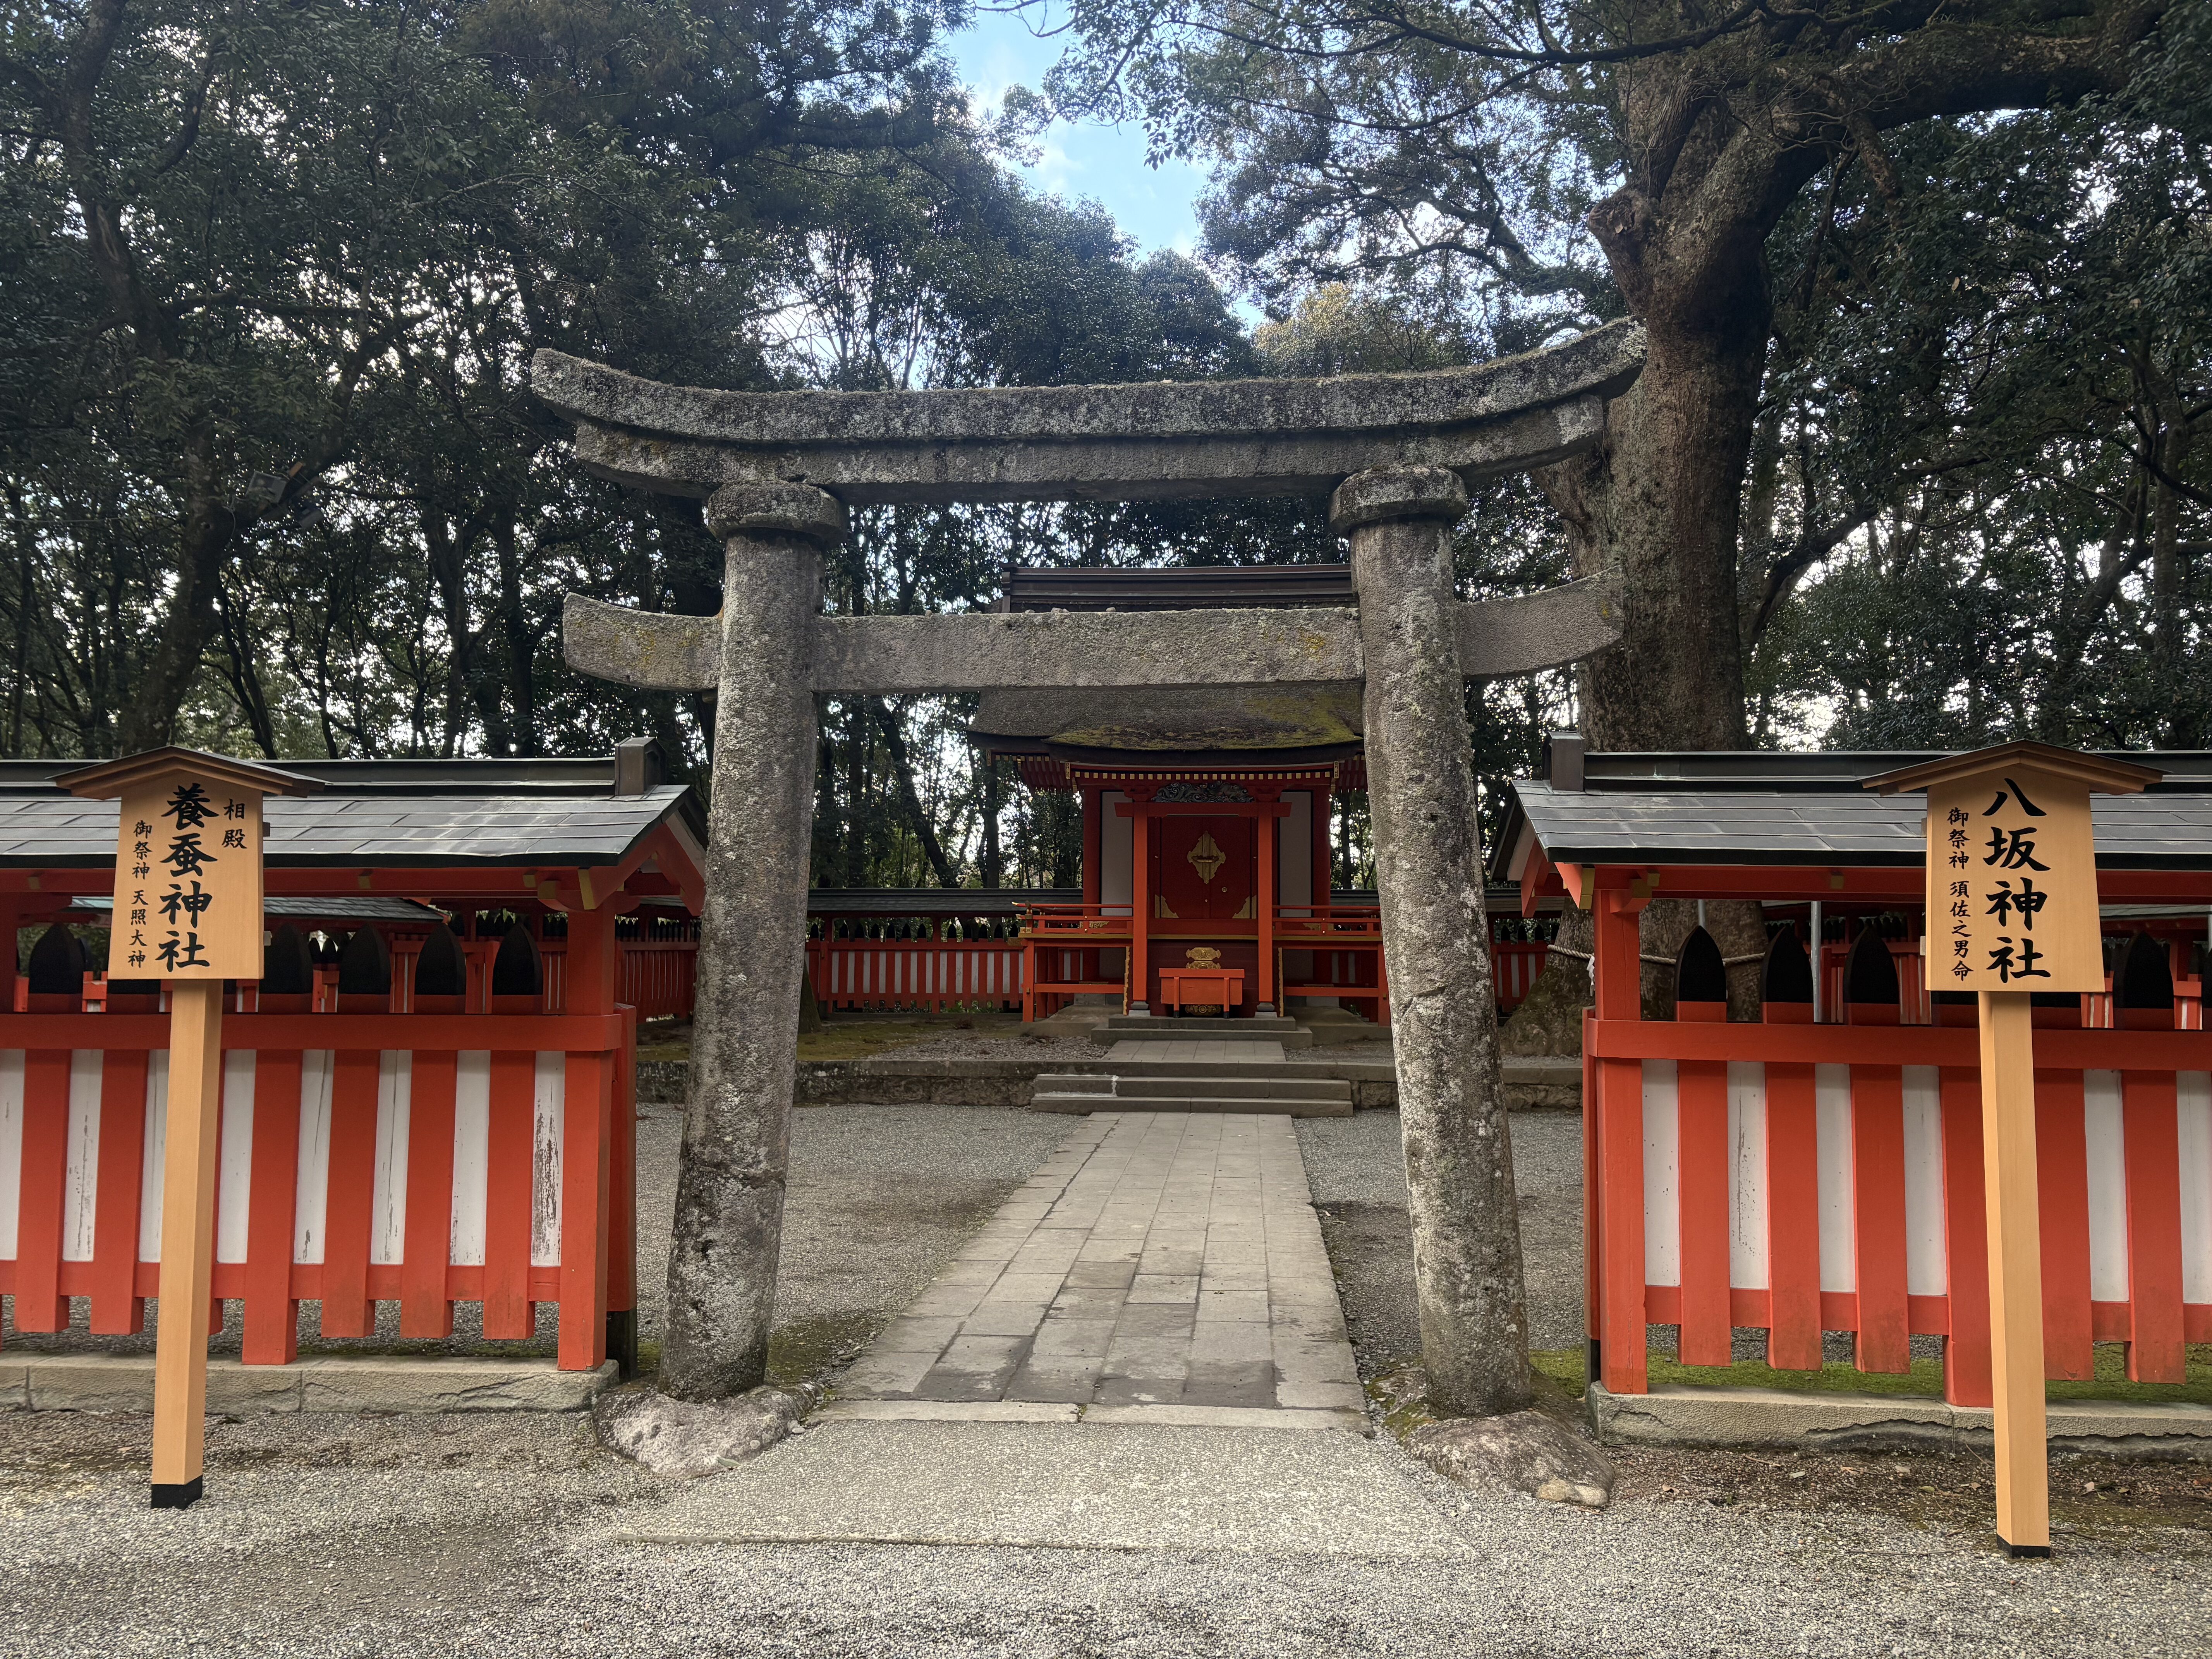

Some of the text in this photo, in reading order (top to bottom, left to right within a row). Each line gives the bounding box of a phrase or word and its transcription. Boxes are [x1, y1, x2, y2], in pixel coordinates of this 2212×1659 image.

[128, 819, 153, 968] 御祭神 天照大神
[155, 783, 220, 972] 養蚕神社
[221, 798, 247, 849] 相殿
[1947, 807, 1974, 981] 御祭神 須佐之男命
[1982, 778, 2051, 984] 八坂神社
